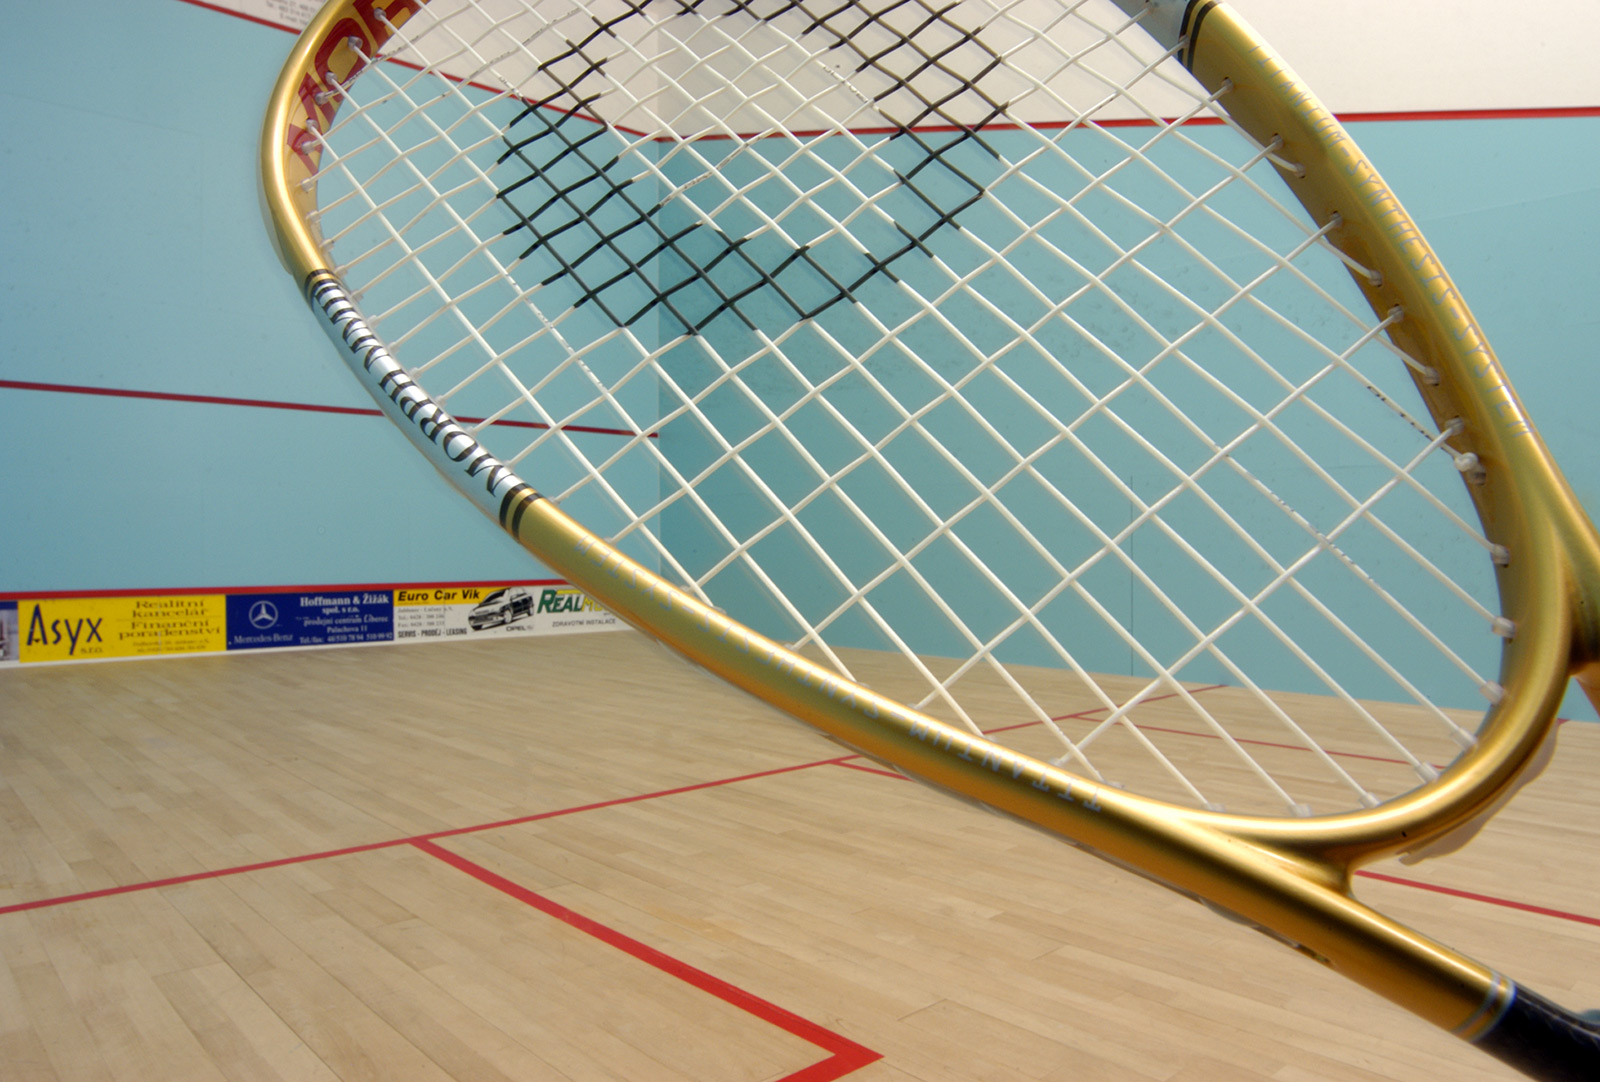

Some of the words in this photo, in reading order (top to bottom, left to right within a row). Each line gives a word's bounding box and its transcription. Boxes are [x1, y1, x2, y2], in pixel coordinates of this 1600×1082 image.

[378, 368, 514, 498] MORPH
[300, 596, 350, 607] Hoffmann
[352, 596, 360, 605] &
[362, 593, 389, 605] Žižák
[398, 591, 429, 602] Euro
[434, 589, 458, 601] Car
[462, 589, 480, 600] Vik
[27, 603, 103, 655] Asyx
